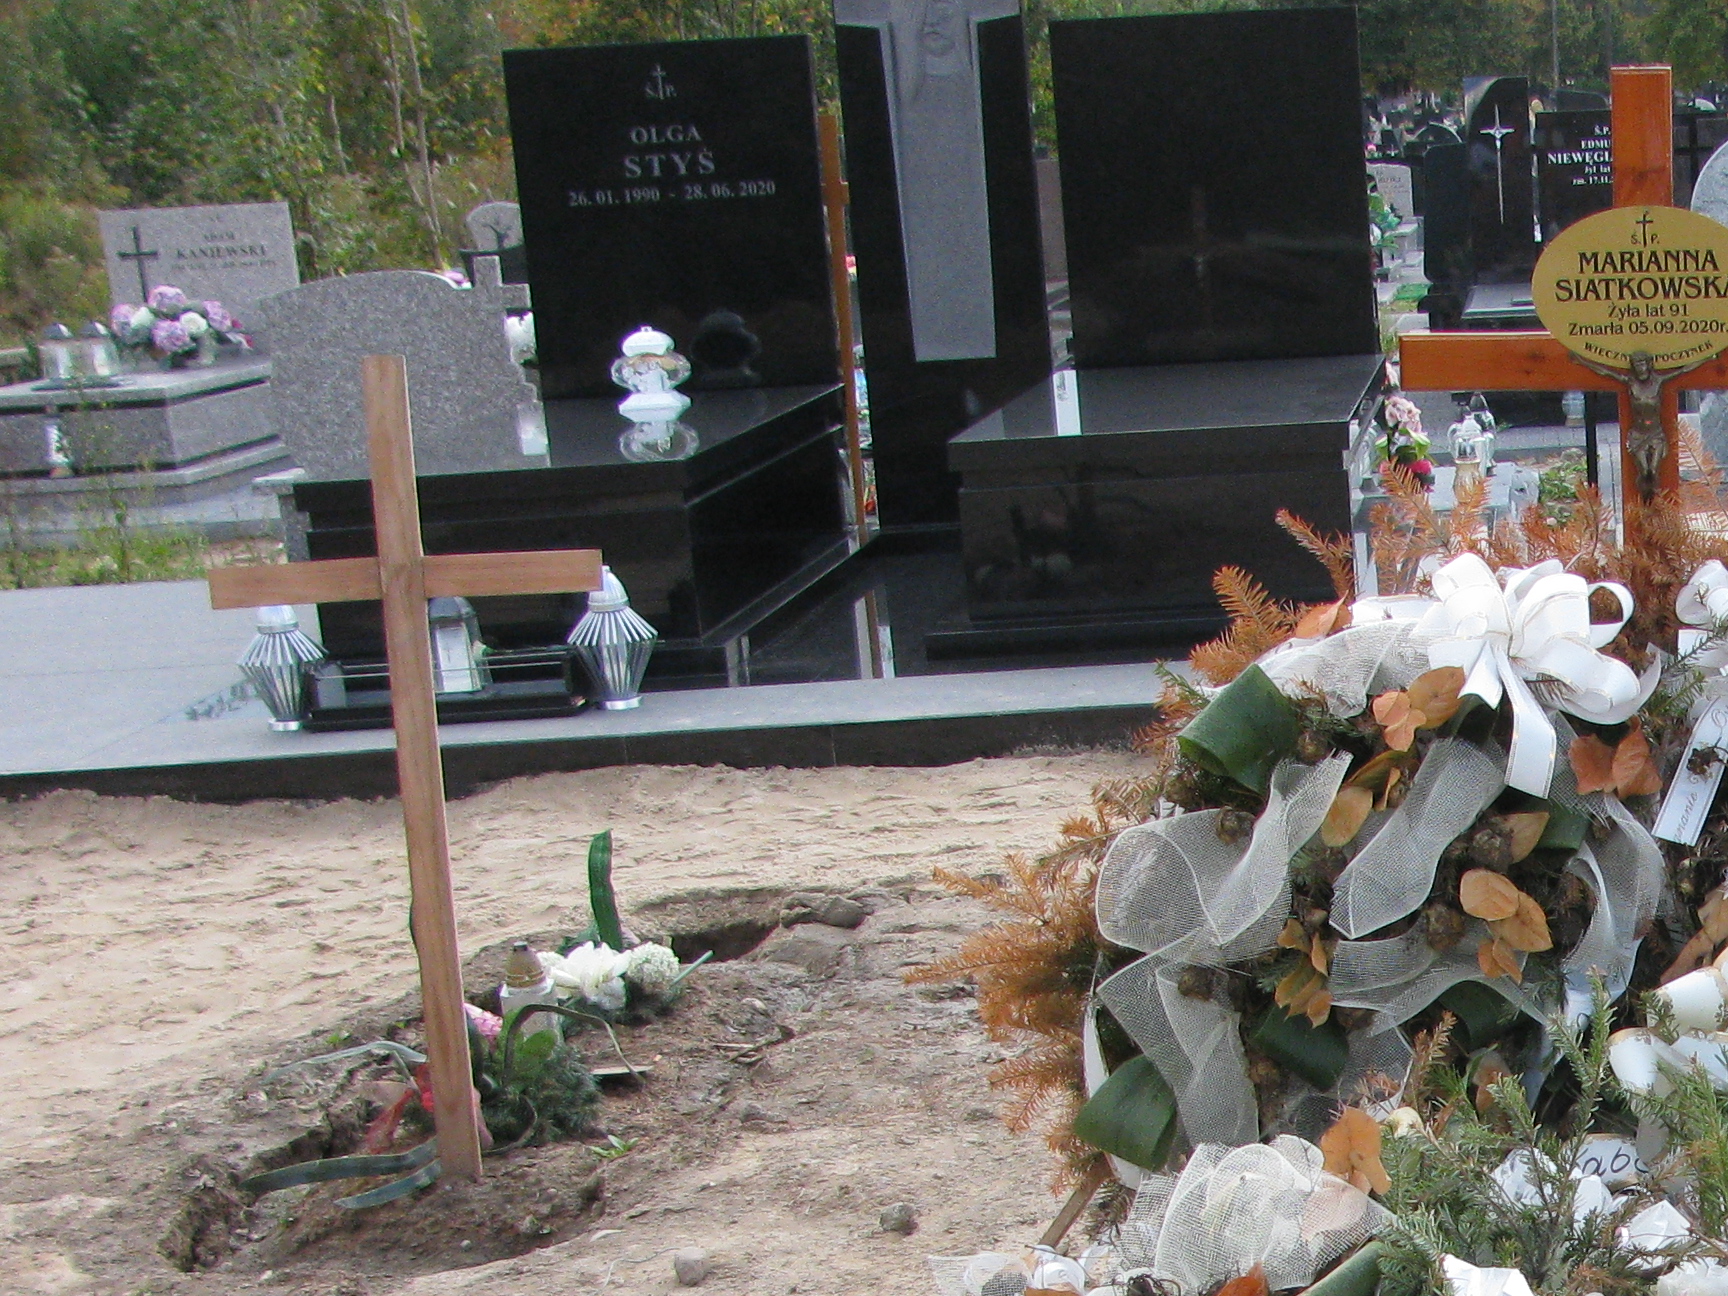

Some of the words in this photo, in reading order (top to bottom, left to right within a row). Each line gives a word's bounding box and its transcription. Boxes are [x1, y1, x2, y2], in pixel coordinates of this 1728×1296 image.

[630, 124, 702, 144] OLGA
[1581, 139, 1612, 150] EDMU
[624, 148, 716, 178] STYŚ
[739, 180, 776, 197] 2020
[1578, 249, 1719, 274] MARIANNA
[1608, 302, 1640, 322] Żyła
[1646, 303, 1664, 318] lat
[1668, 303, 1689, 317] 91
[1569, 321, 1624, 337] Zmarła
[1583, 341, 1630, 362] WIECZN
[1651, 339, 1715, 363] POCZYNEK
